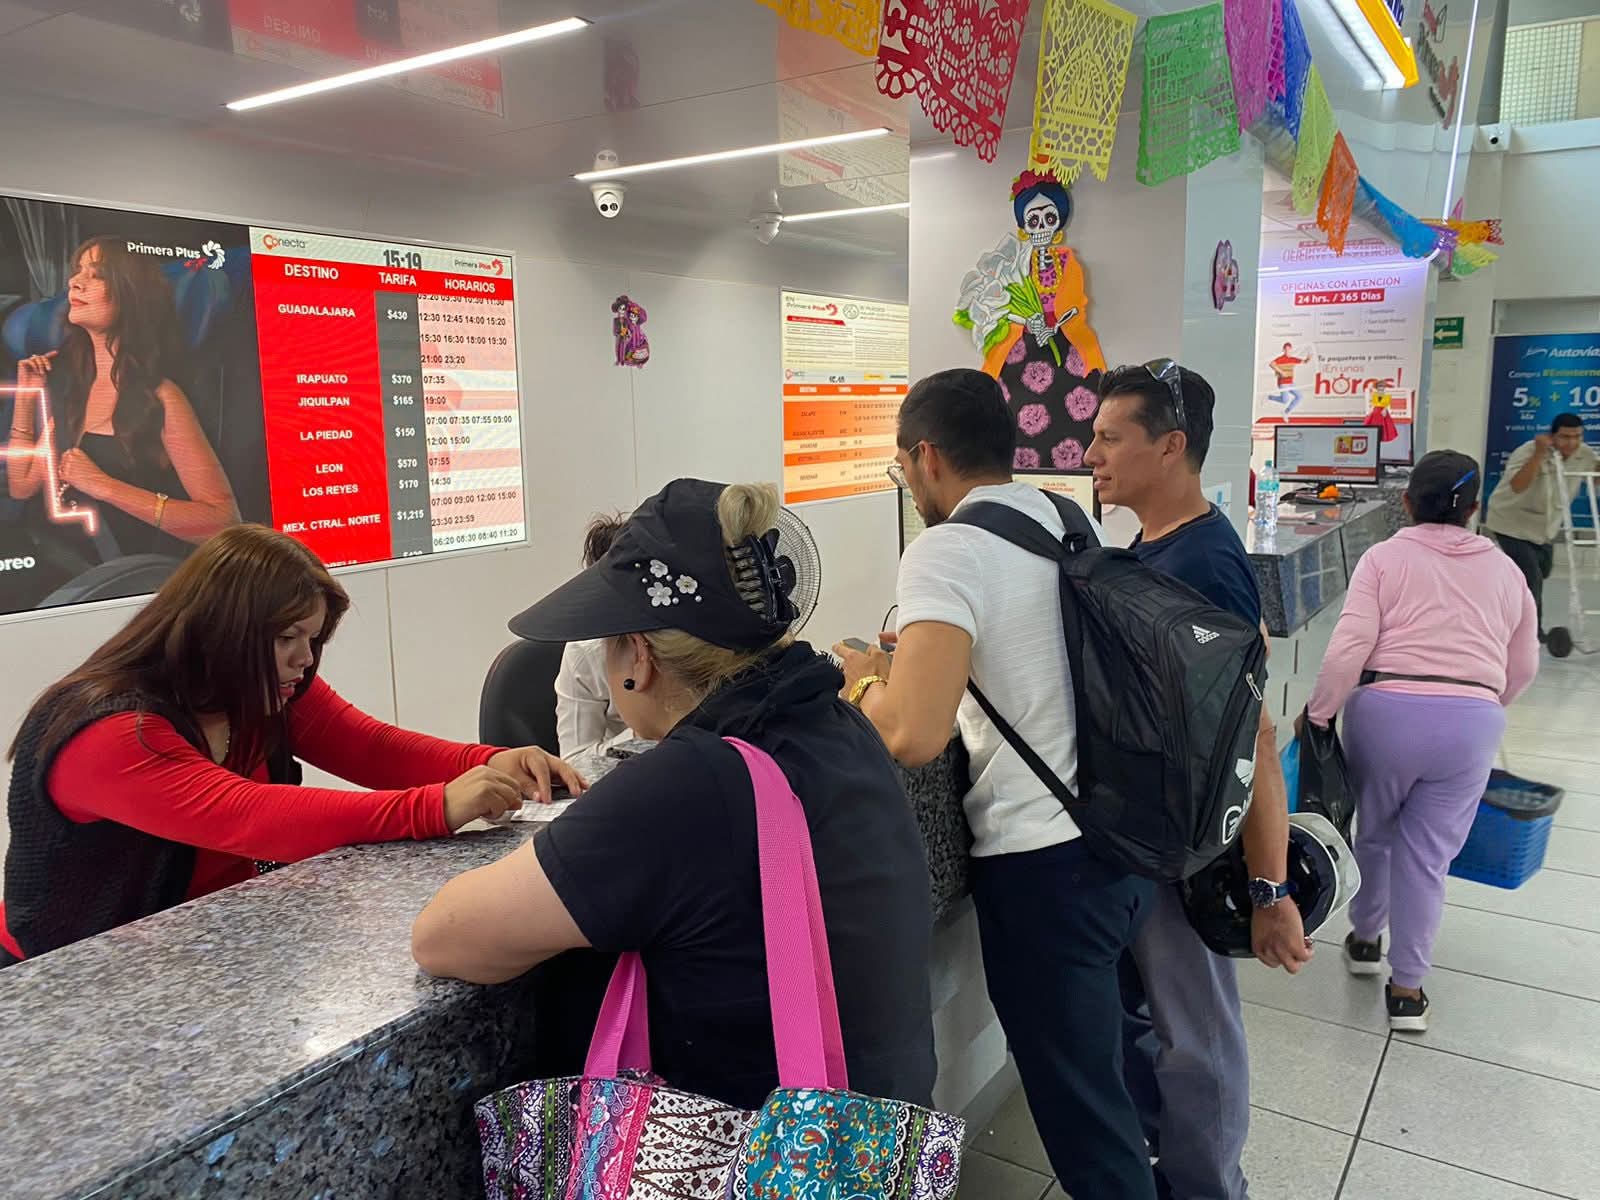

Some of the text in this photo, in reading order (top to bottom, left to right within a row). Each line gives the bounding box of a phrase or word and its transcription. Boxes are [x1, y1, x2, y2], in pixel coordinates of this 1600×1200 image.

[263, 234, 306, 250] Conecta
[127, 242, 201, 259] Primera Plus
[383, 249, 422, 270] 15:19
[284, 263, 496, 293] DESTINO TARIFA HORARIOS
[1281, 276, 1401, 292] OFICINAS CON ATENCIÓN
[1297, 294, 1310, 304] 24
[1312, 293, 1330, 303] hrs.
[1339, 292, 1359, 301] 365
[278, 303, 408, 321] GUADALAJARA $430
[419, 313, 506, 326] 12:30 12:45 14:00 15:20
[420, 334, 442, 343] 15:30
[420, 354, 466, 364] 21:00 23:20
[296, 374, 445, 385] IRAPUATO $370 07:35
[298, 395, 446, 407] JIQUILPAN $165 19:00
[426, 416, 448, 425] 07:00
[449, 416, 471, 425] 07:35
[471, 415, 492, 424] 07:55
[299, 427, 416, 441] LA PIEDAD $150
[427, 435, 471, 446] 12:00 15:00
[315, 457, 450, 474] LEON $570 07:55
[302, 477, 452, 497] LOS REYES $170 14:30
[431, 496, 453, 507] 07:00
[476, 493, 496, 503] 12:00
[497, 491, 517, 500] 15:00
[282, 508, 424, 534] MEX. CTRAL. NORTE $1,215
[431, 516, 453, 527] 23:30
[499, 528, 518, 538] 11:20
